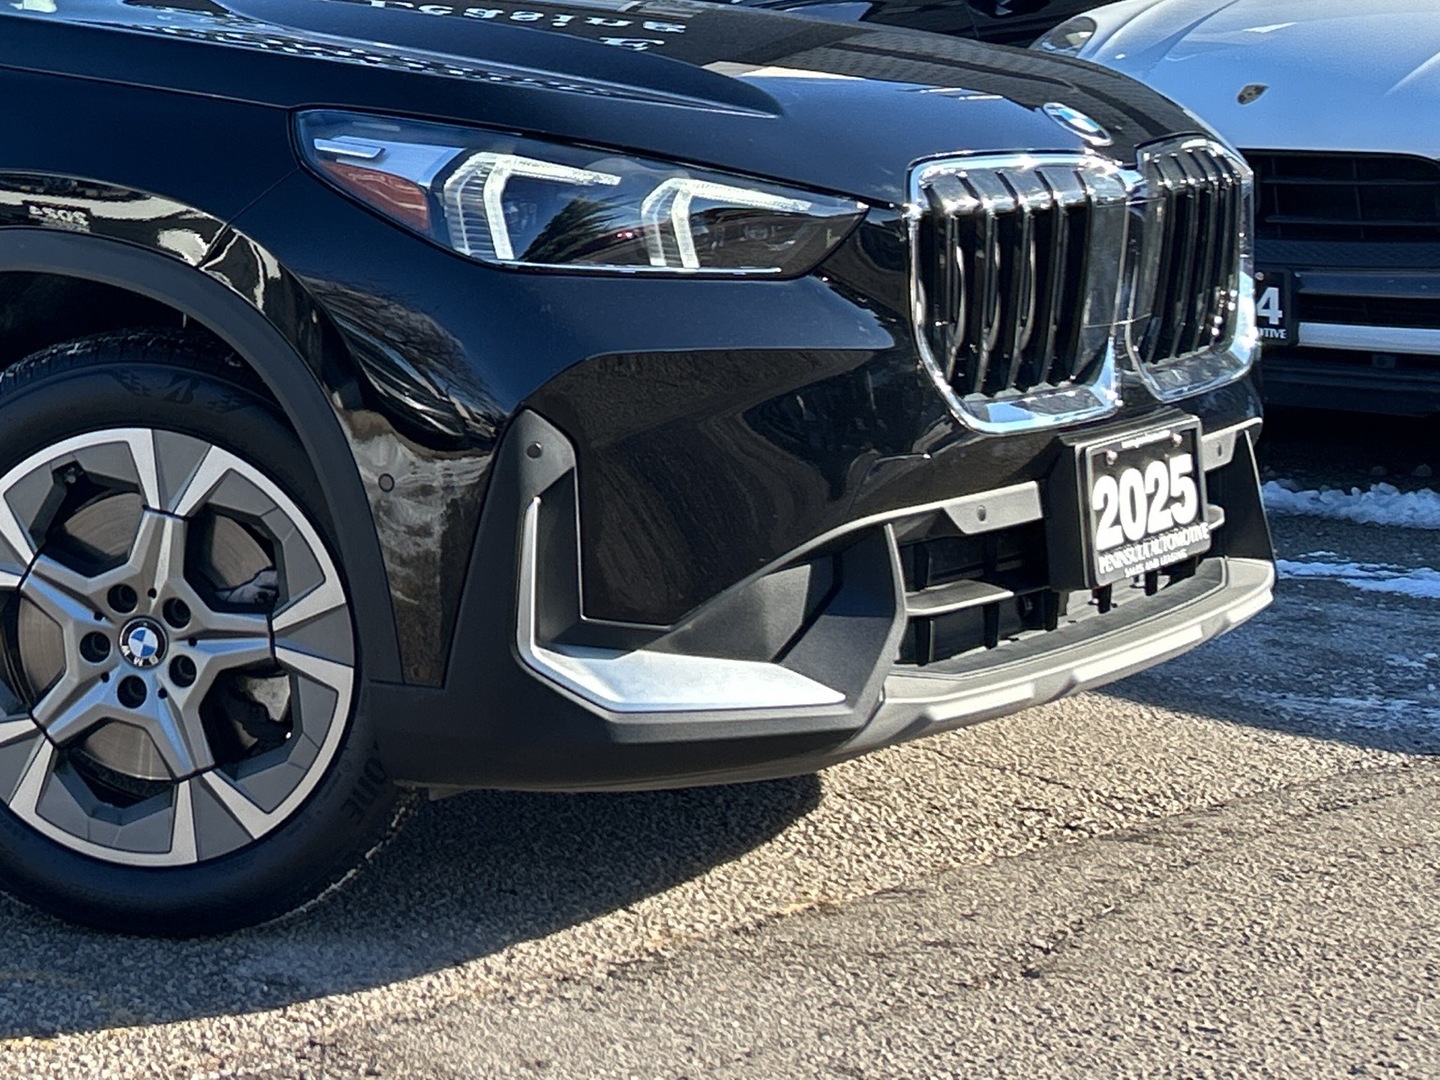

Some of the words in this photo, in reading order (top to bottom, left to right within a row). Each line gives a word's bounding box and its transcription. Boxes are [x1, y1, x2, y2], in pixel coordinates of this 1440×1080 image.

[1257, 286, 1283, 325] 4
[1091, 453, 1198, 551] 2025
[122, 645, 159, 667] BMW
